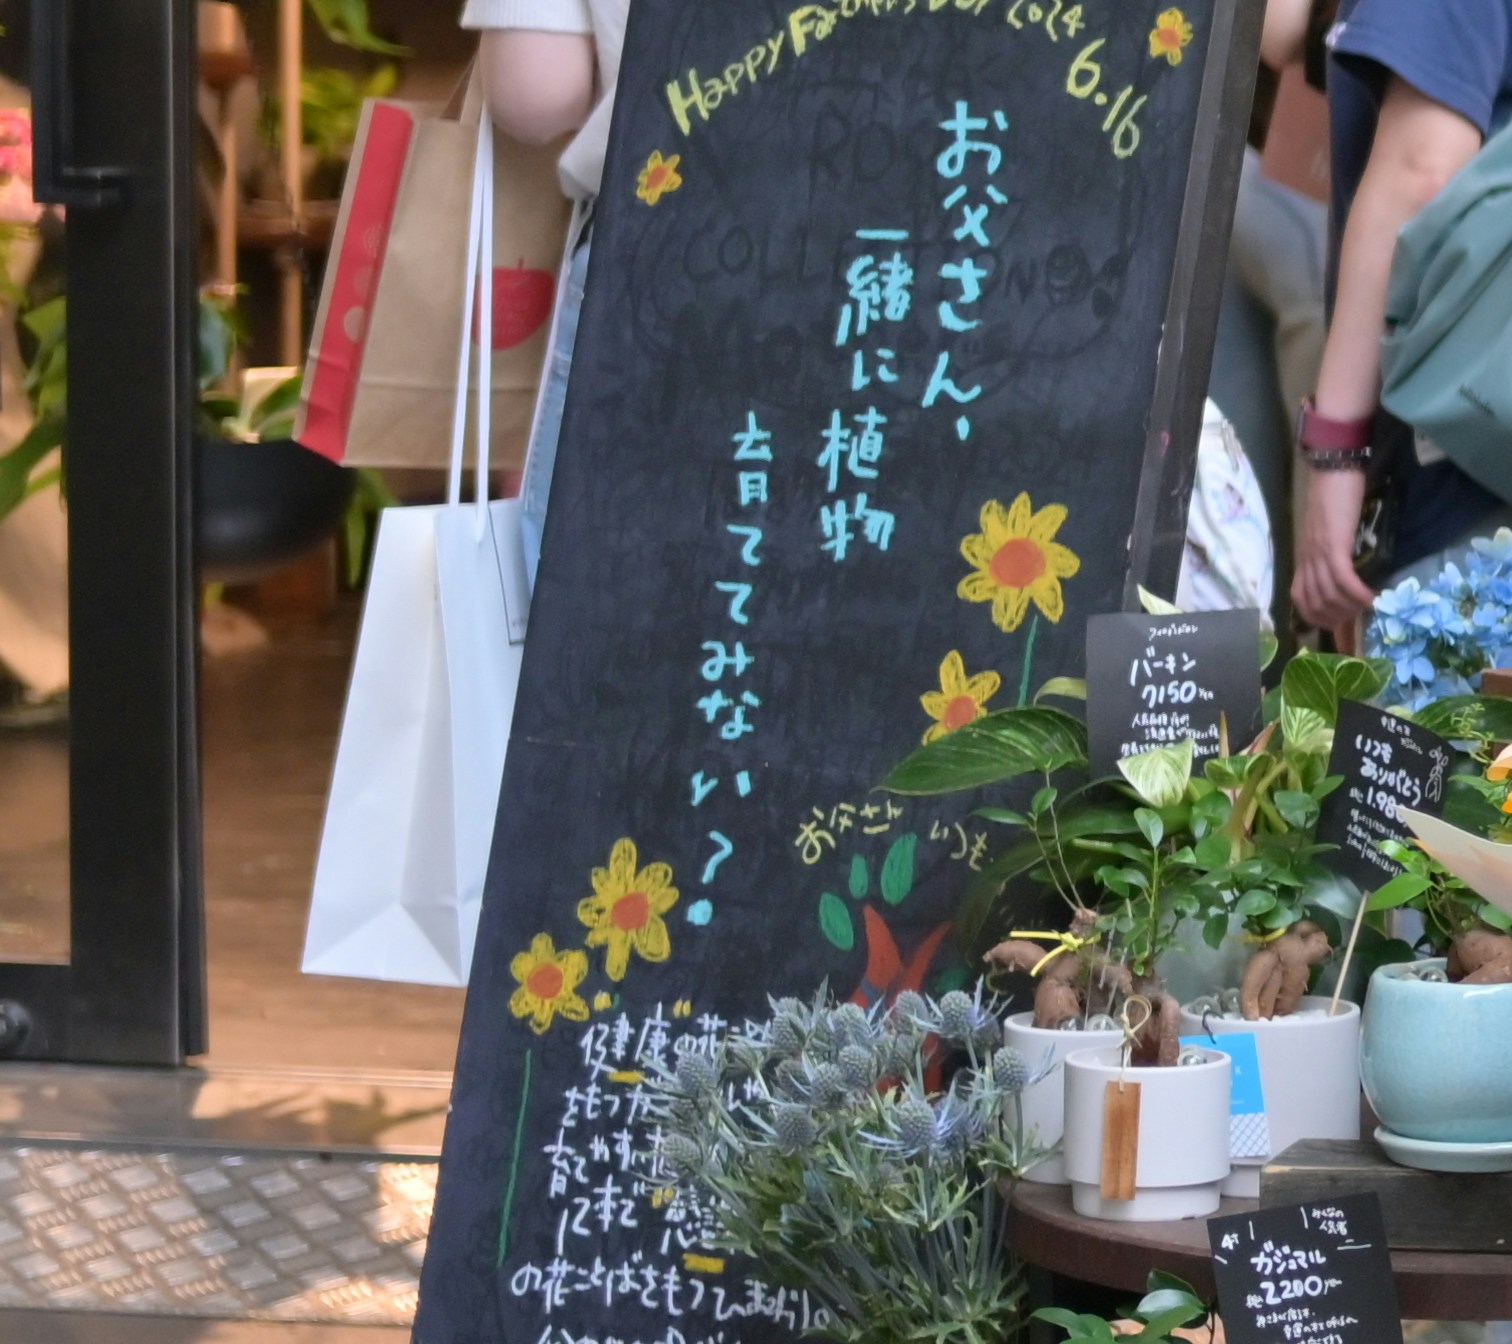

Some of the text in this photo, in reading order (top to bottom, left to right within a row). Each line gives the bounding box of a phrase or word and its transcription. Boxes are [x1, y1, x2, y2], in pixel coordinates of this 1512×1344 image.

[666, 31, 784, 136] Happy
[1067, 38, 1147, 158] 6.16
[1129, 646, 1196, 686] バーキン
[1355, 734, 1393, 764] いつも
[1360, 756, 1421, 806] ありがとう
[1259, 1275, 1323, 1306] 2200
